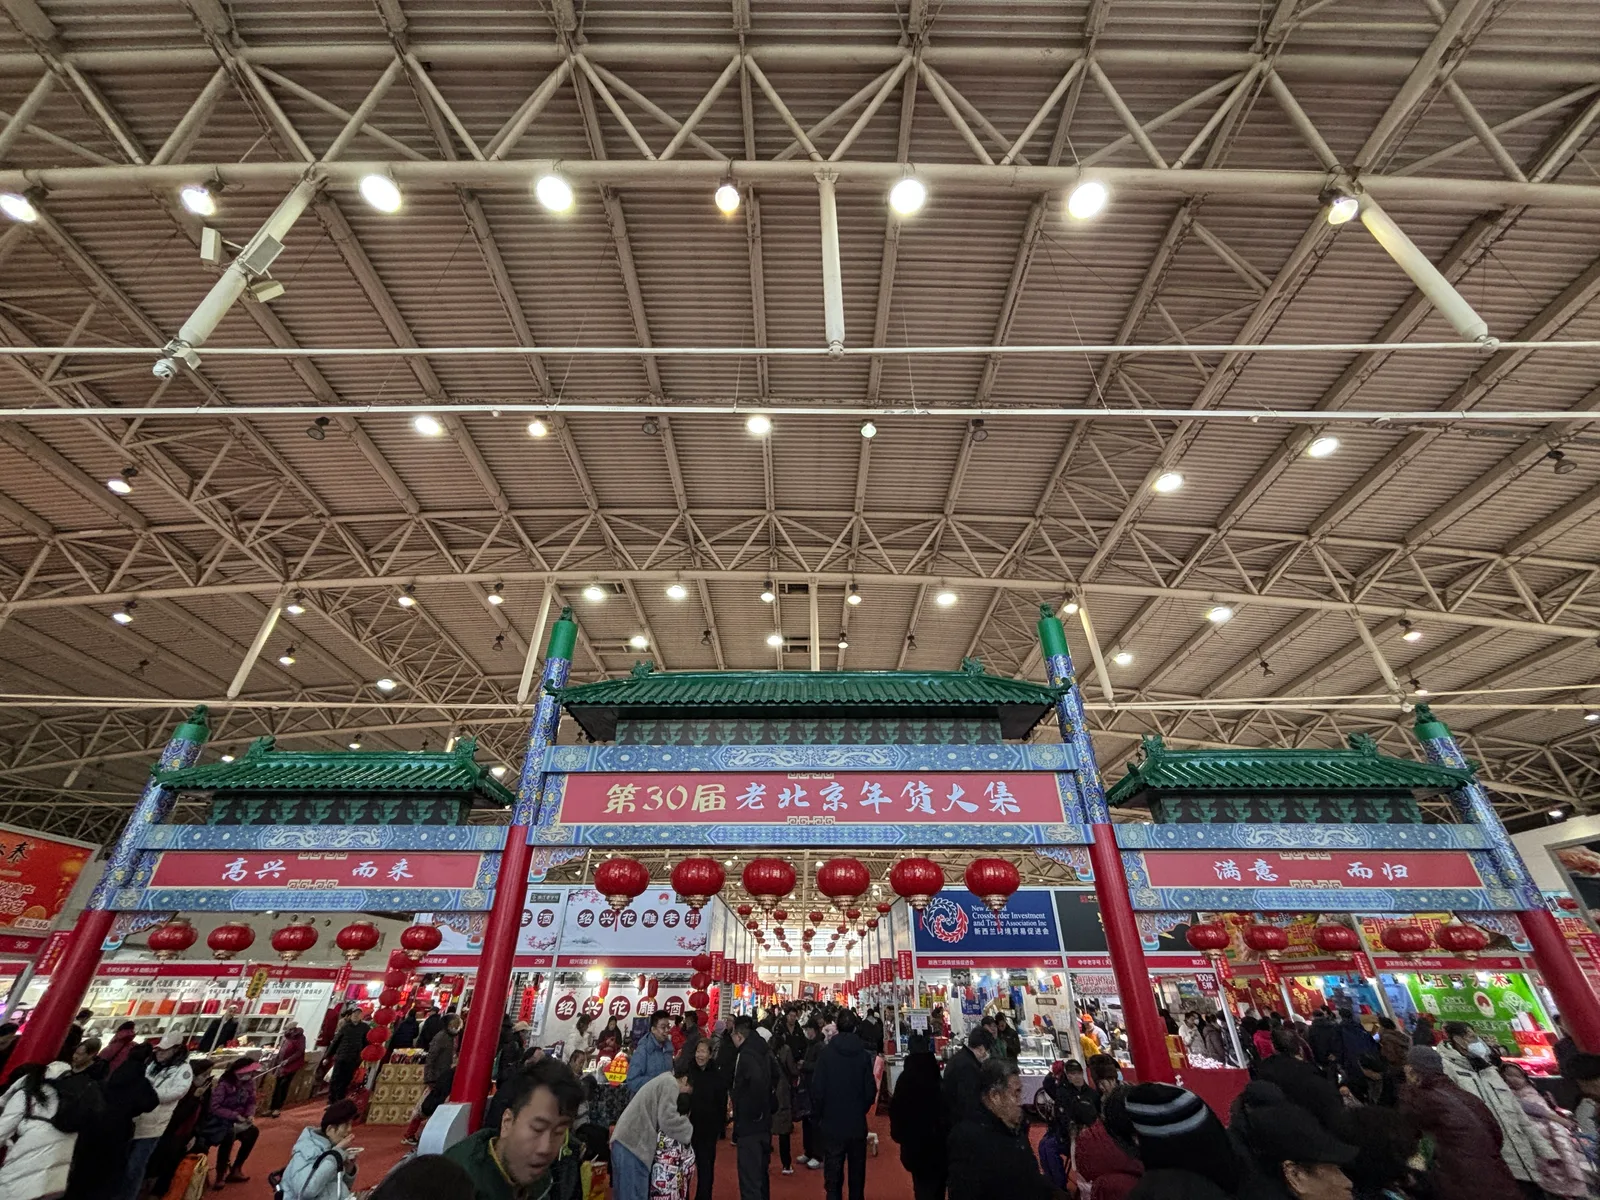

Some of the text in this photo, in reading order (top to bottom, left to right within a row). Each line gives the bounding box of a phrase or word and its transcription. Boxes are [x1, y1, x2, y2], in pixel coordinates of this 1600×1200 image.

[603, 781, 1021, 816] 第30届老北京年货大集
[577, 910, 702, 928] 绍兴花雕老酒
[556, 1000, 683, 1016] 绍兴花雕酒
